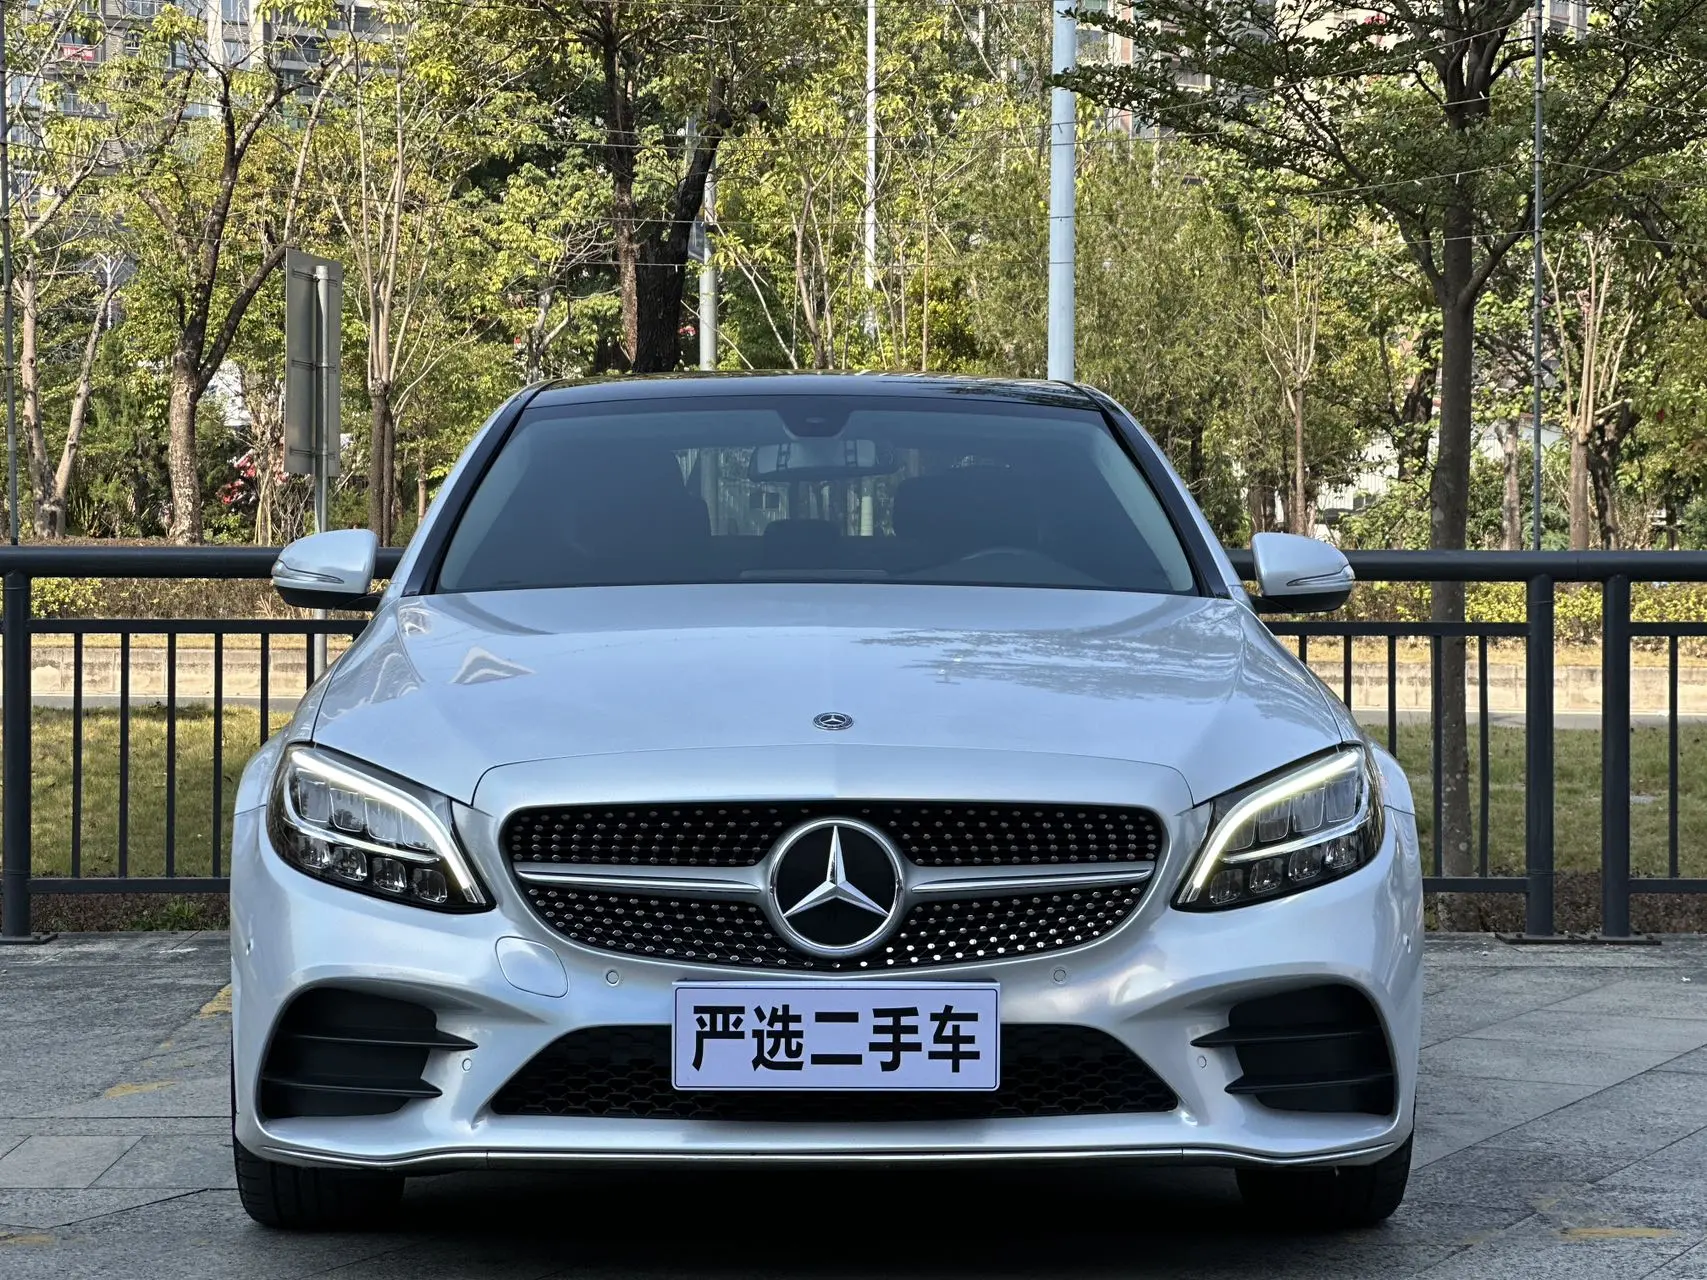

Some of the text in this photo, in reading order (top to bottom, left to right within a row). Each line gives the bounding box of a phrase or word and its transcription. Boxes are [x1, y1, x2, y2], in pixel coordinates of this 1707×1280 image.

[692, 1004, 980, 1073] 严选二手车
